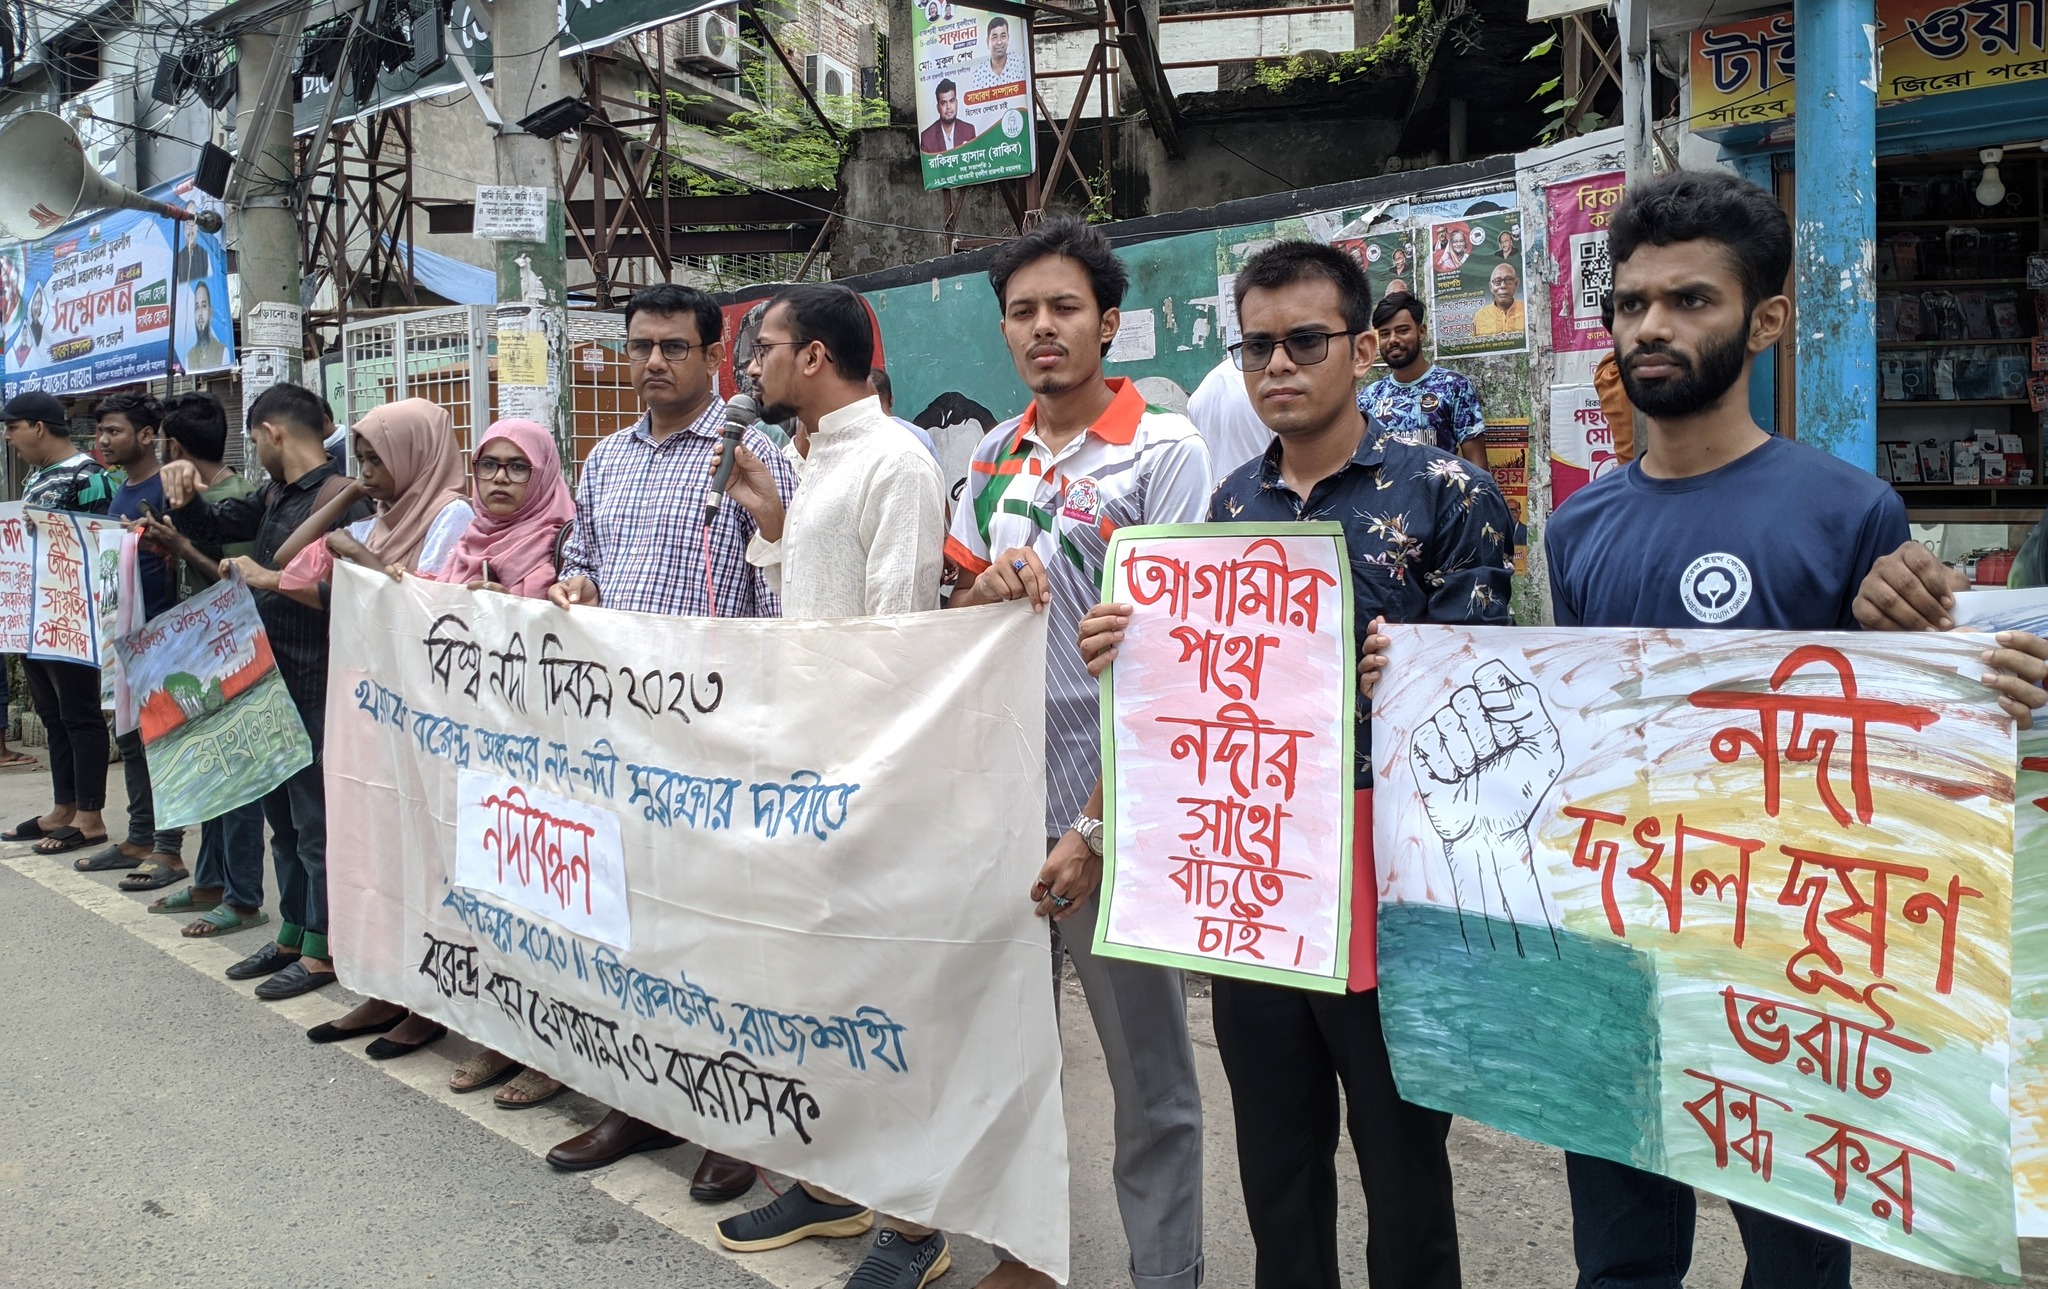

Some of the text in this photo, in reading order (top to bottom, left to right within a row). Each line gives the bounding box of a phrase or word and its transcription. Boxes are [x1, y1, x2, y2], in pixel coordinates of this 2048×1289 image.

[967, 84, 1019, 103] সাধারণ সম্পাদক
[1708, 59, 2048, 123] সাহেব জিরো পয়ে
[928, 141, 1022, 169] রাকিবুল হাসান (রাকিব)
[1576, 183, 1625, 211] বিকা
[51, 281, 133, 335] সম্মেলন
[258, 308, 287, 320] ড়ানো
[1585, 398, 1600, 407] বিকা
[1120, 538, 1337, 634] আগামীর
[1708, 609, 1730, 620] YOUTH
[1730, 591, 1748, 613] FORUM
[208, 620, 238, 663] নদী
[423, 614, 724, 724] বিশ্ব নদী দিবস ২০২৩
[1169, 626, 1279, 701] পথে
[1154, 702, 1315, 801] নদীর
[1688, 643, 1940, 827] নদী
[411, 710, 469, 769] বরেন্দ্র
[545, 739, 620, 800] নদ-নদী
[626, 763, 742, 831] সুরক্ষার
[749, 769, 860, 841] দাবীতে
[480, 785, 596, 915] নদীবন্ধন
[1175, 796, 1294, 870] সাথে
[1168, 843, 1313, 918] বাঁচতে
[1563, 805, 1984, 1004] দখল দূষণ
[1194, 913, 1288, 960] চাই
[529, 987, 630, 1082] ফোরাম
[624, 1033, 658, 1086] ও
[655, 1041, 821, 1145] বারসিক
[734, 1004, 910, 1073] রাজশাহী
[1719, 983, 1932, 1099] ভরাট
[1682, 1068, 1956, 1234] বন্ধ কর
